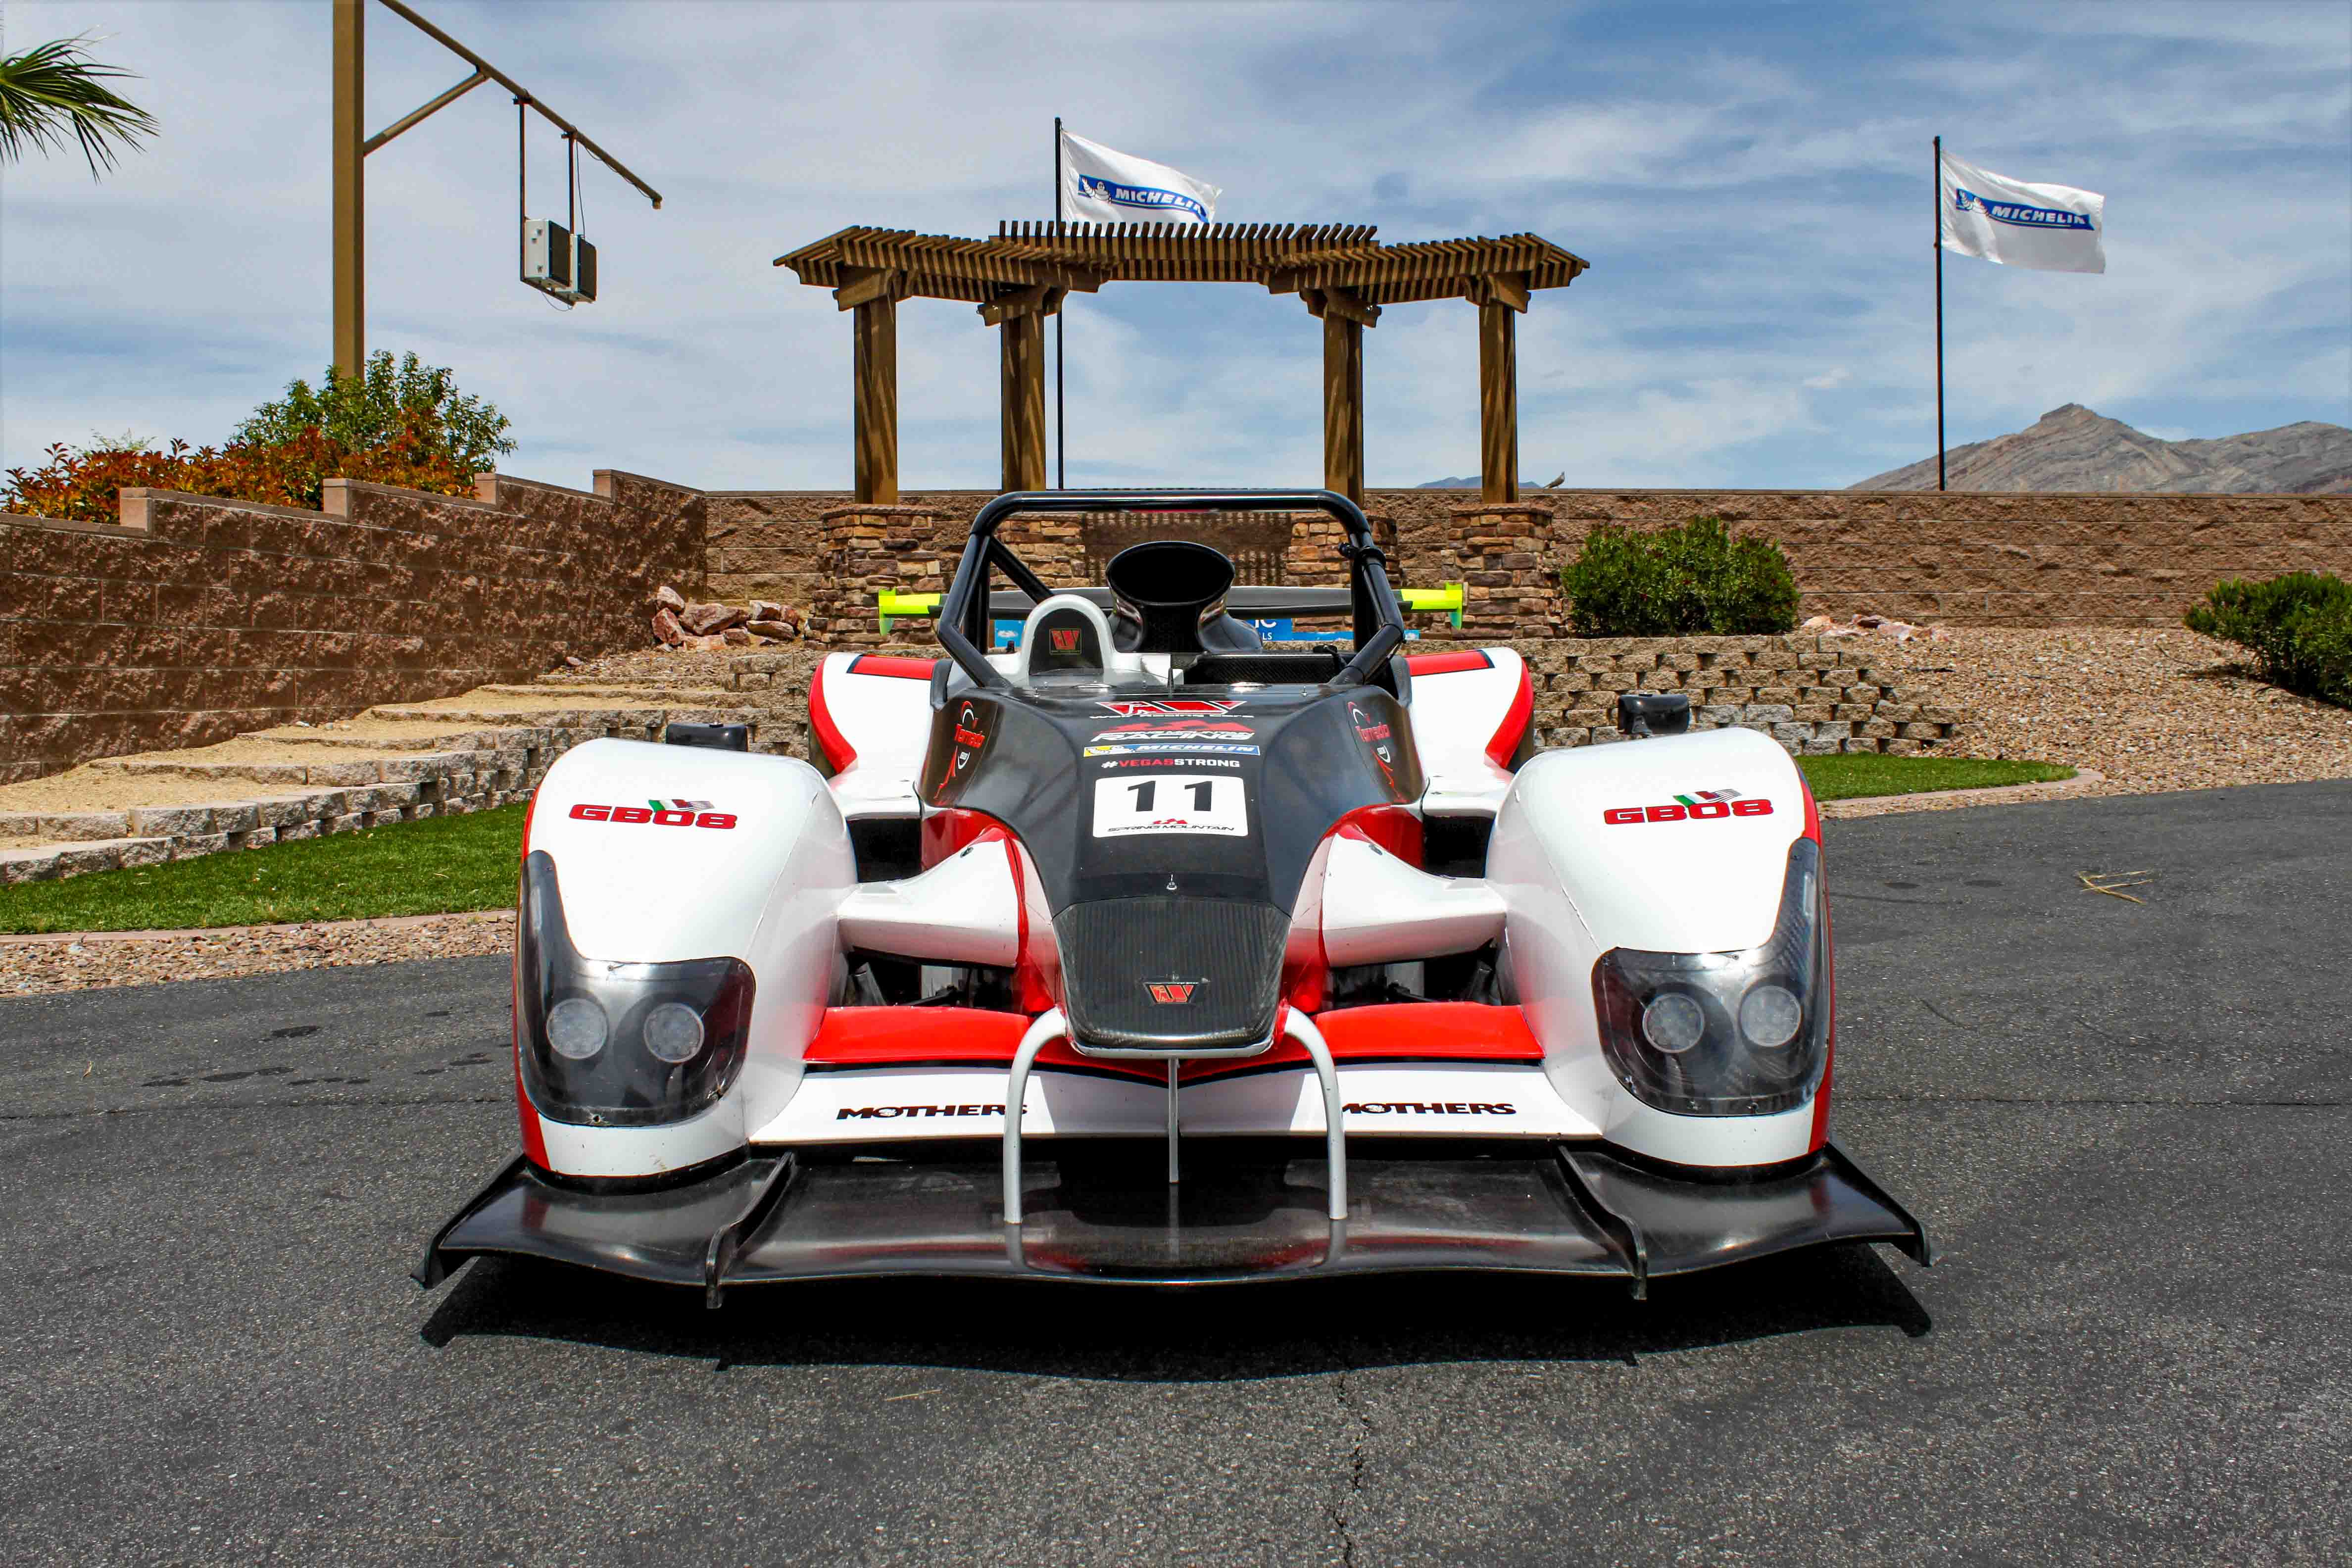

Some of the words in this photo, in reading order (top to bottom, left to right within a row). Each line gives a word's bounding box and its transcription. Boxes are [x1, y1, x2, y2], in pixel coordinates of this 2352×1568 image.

[1090, 733, 1254, 742] RACING
[1101, 758, 1240, 768] #VEGASSTRONG
[1127, 781, 1212, 812] 11
[569, 804, 737, 829] GB08
[1603, 799, 1774, 825] GB08
